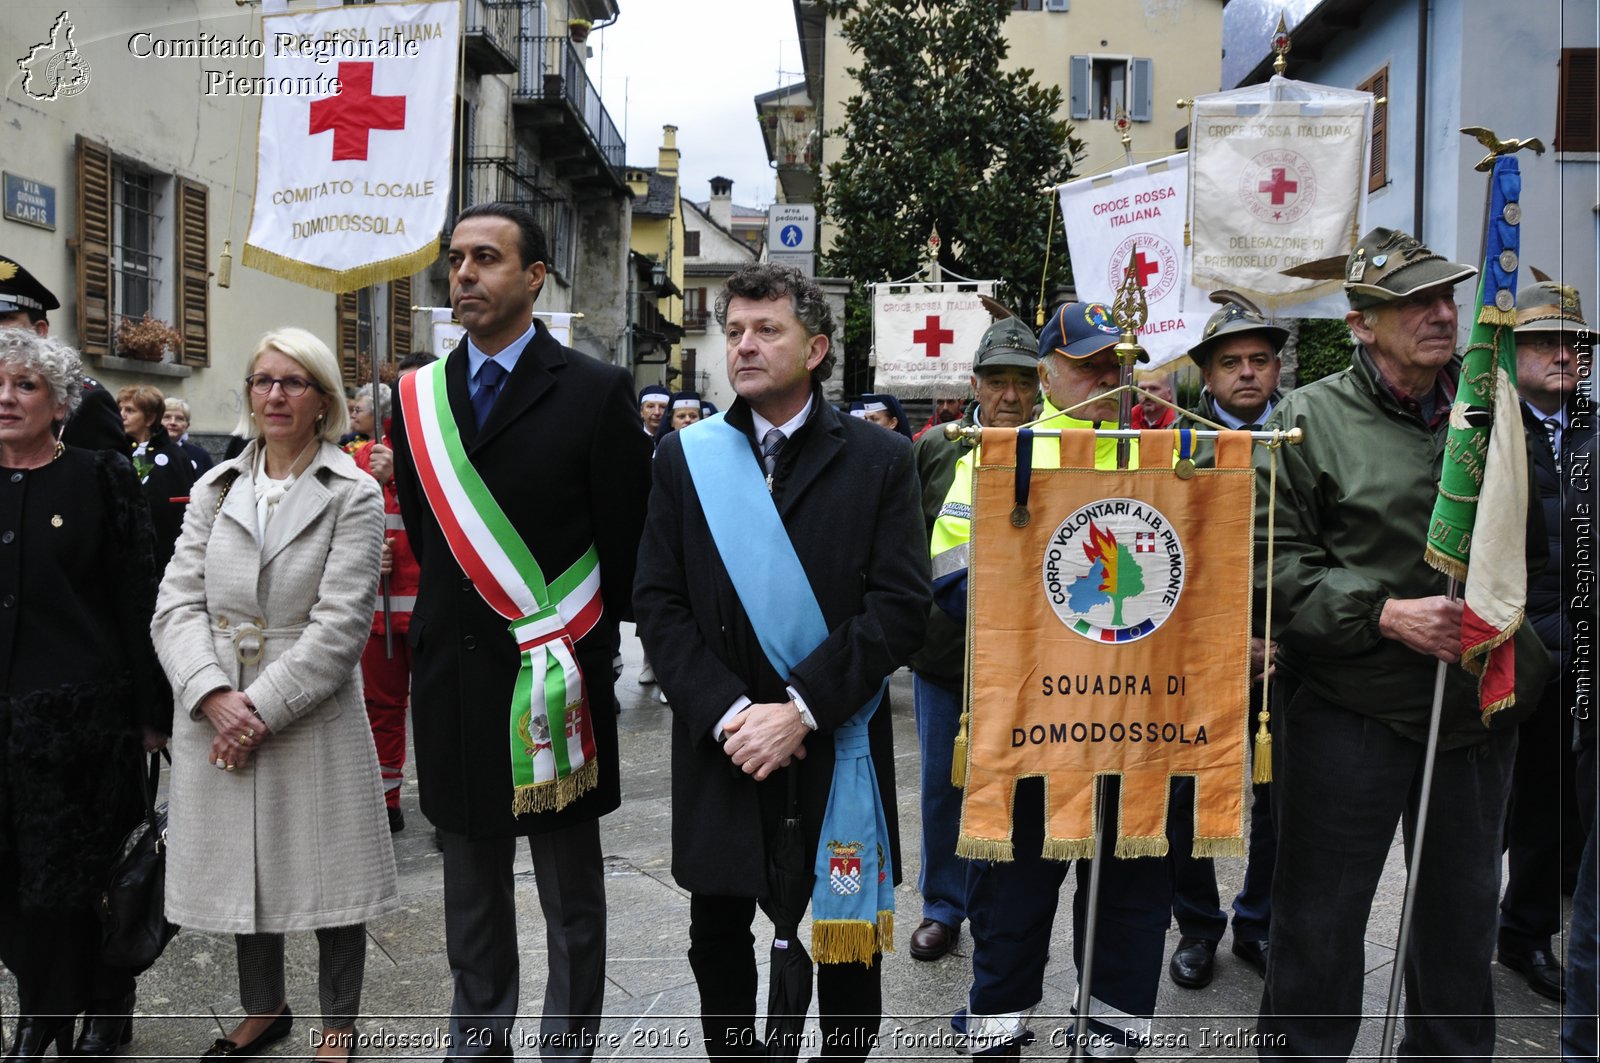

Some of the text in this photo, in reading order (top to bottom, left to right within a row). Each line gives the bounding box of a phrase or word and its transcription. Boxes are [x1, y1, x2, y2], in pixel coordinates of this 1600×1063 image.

[378, 22, 442, 42] ITALIANA
[1297, 124, 1352, 137] ITALIANA
[22, 179, 41, 196] VIA
[272, 180, 435, 205] COMITATO LOCALE
[1092, 187, 1176, 216] CROCE ROSSA
[16, 202, 48, 224] CAPIS
[775, 214, 809, 222] pedonale
[1110, 206, 1162, 229] ITALIANA
[292, 214, 406, 240] DOMODOSSOLA
[1229, 236, 1324, 250] DELEGAZIONE DI
[1203, 254, 1278, 268] PREMOSELLO
[883, 302, 911, 313] CROCE
[914, 301, 942, 312] ROSSA
[907, 362, 937, 372] LOCALE
[941, 362, 950, 371] DI
[952, 362, 973, 371] STRE
[948, 502, 971, 513] REGION
[1431, 518, 1453, 544] DI
[1047, 502, 1182, 607] CORPO VOLONTARI A.I.B. PIEMONTE
[1042, 675, 1186, 696] SQUADRA DI
[1011, 722, 1209, 748] DOMODOSSOLA
